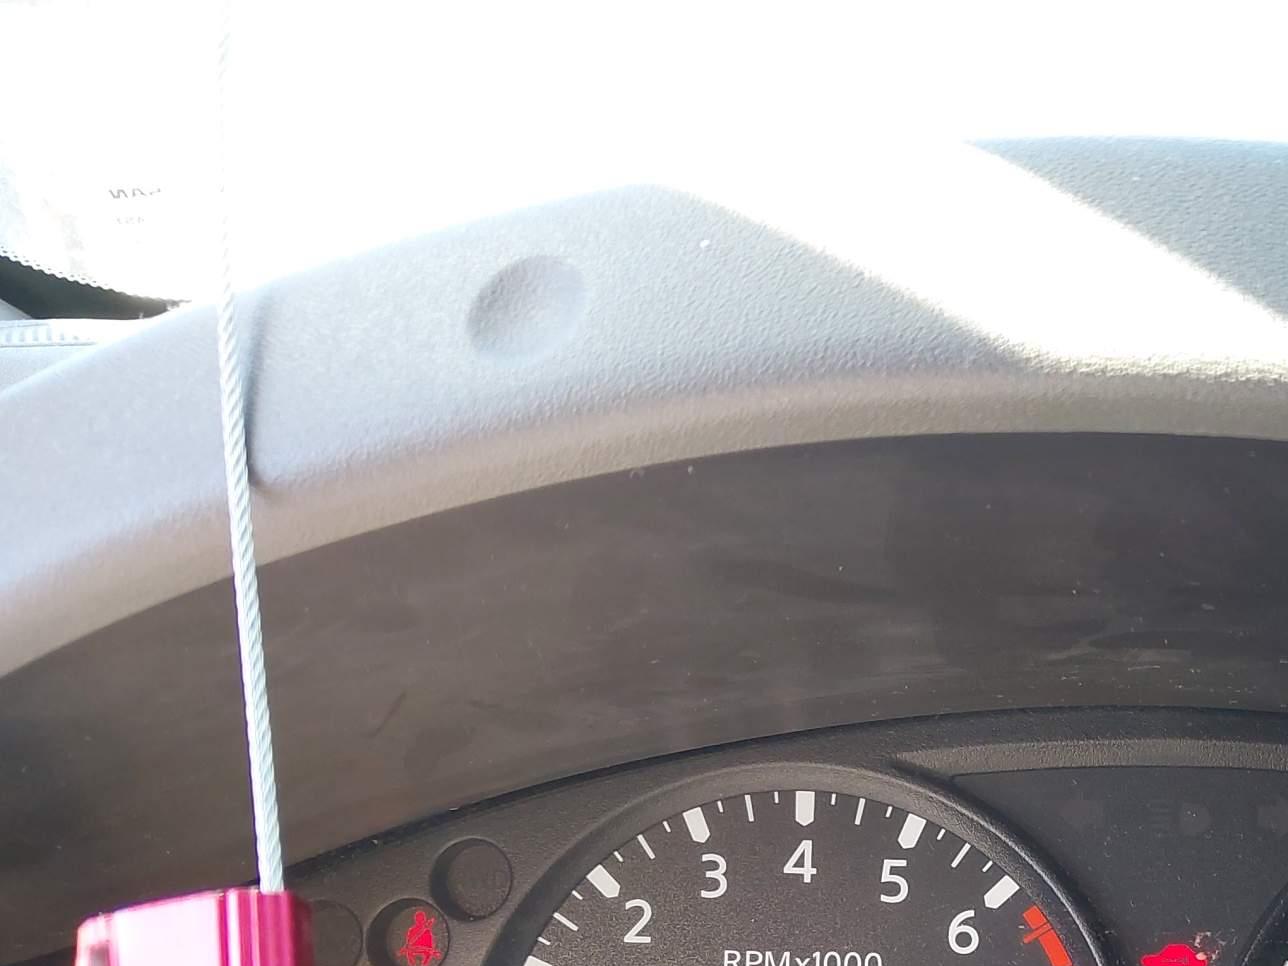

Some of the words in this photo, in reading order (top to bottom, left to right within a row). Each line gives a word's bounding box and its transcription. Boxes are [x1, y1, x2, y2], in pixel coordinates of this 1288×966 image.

[700, 853, 728, 899] 3
[783, 839, 817, 883] 4
[880, 858, 909, 904] 5
[623, 898, 652, 944] 2
[948, 909, 980, 955] 6
